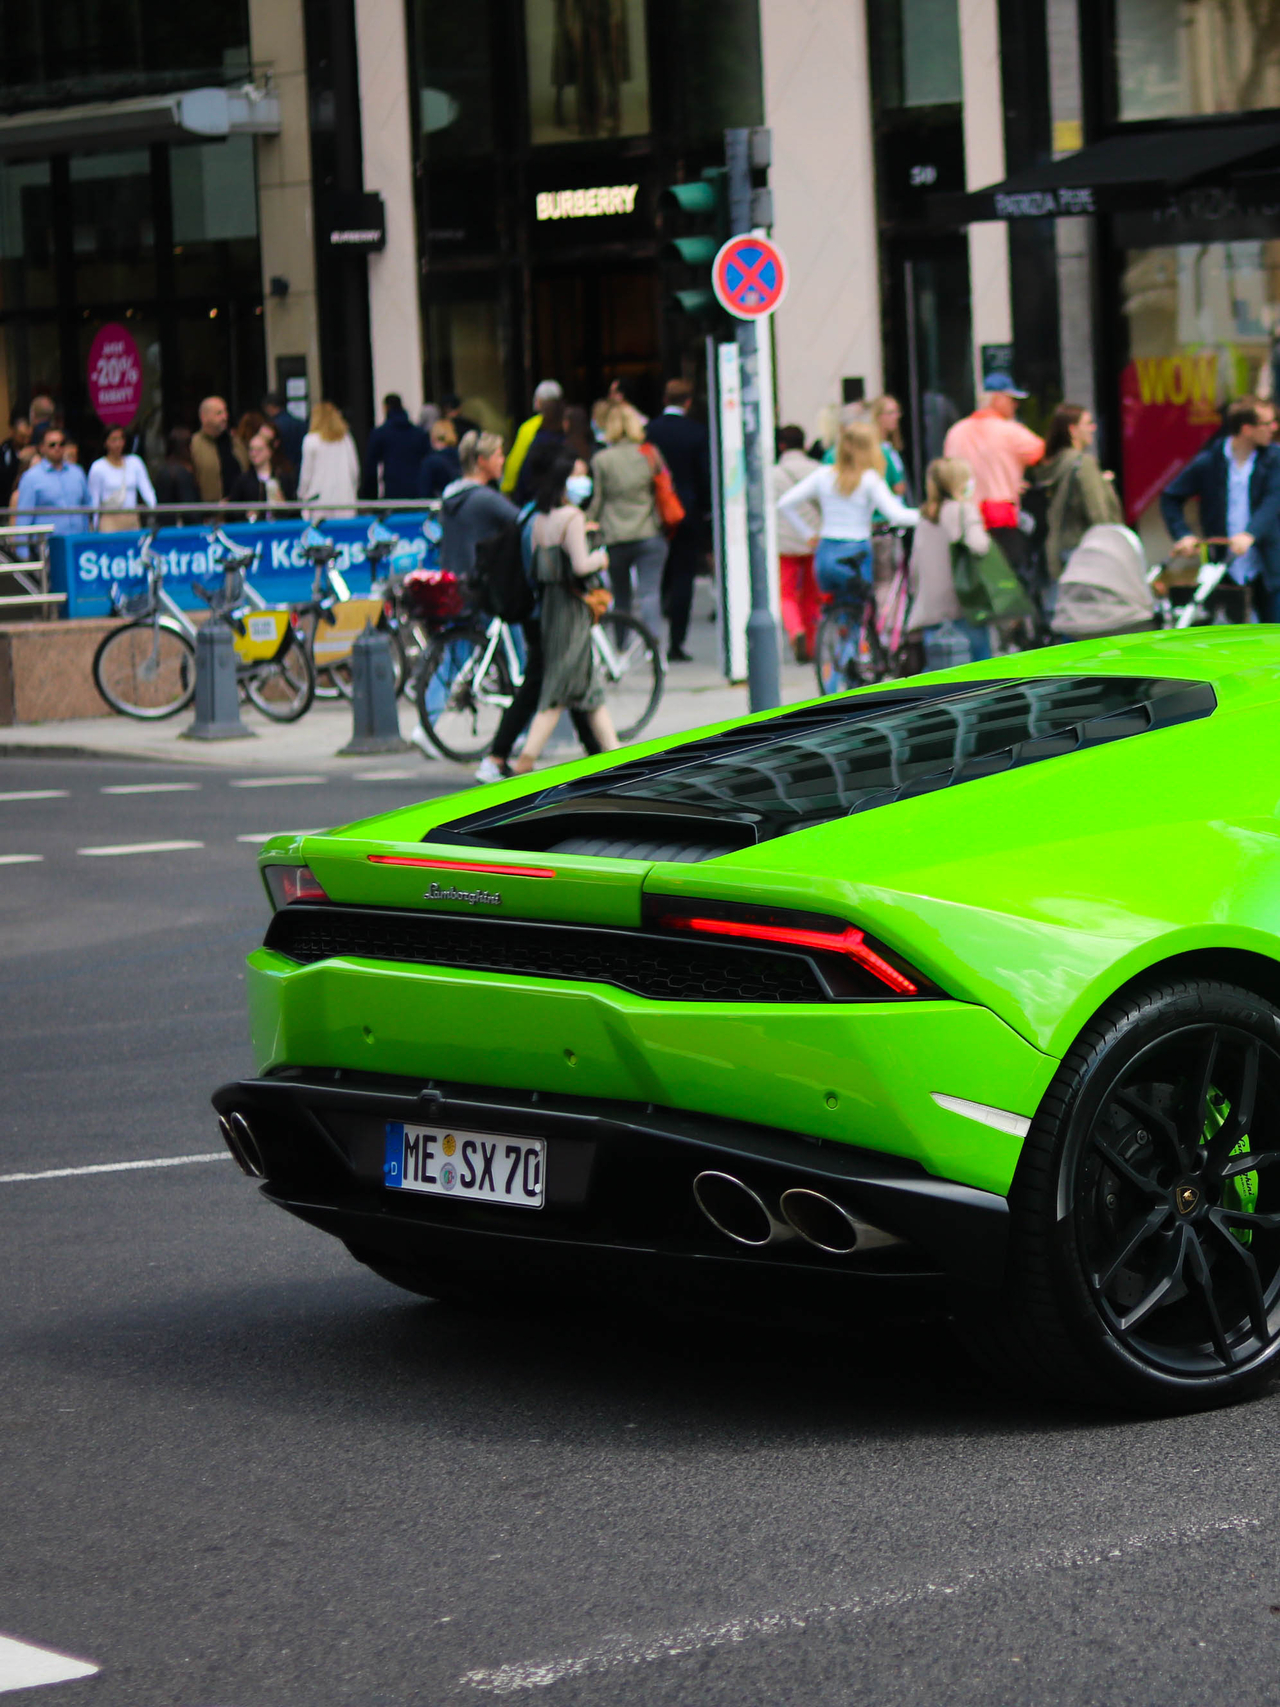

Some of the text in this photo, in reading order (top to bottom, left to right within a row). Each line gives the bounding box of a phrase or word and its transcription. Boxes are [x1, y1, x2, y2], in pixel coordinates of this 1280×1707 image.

[536, 184, 639, 220] BURBERRY
[91, 353, 139, 387] -20%
[1135, 355, 1218, 405] WOW
[423, 882, 502, 905] Lamborghini
[390, 1161, 398, 1176] D
[403, 1132, 540, 1197] ME SX 70
